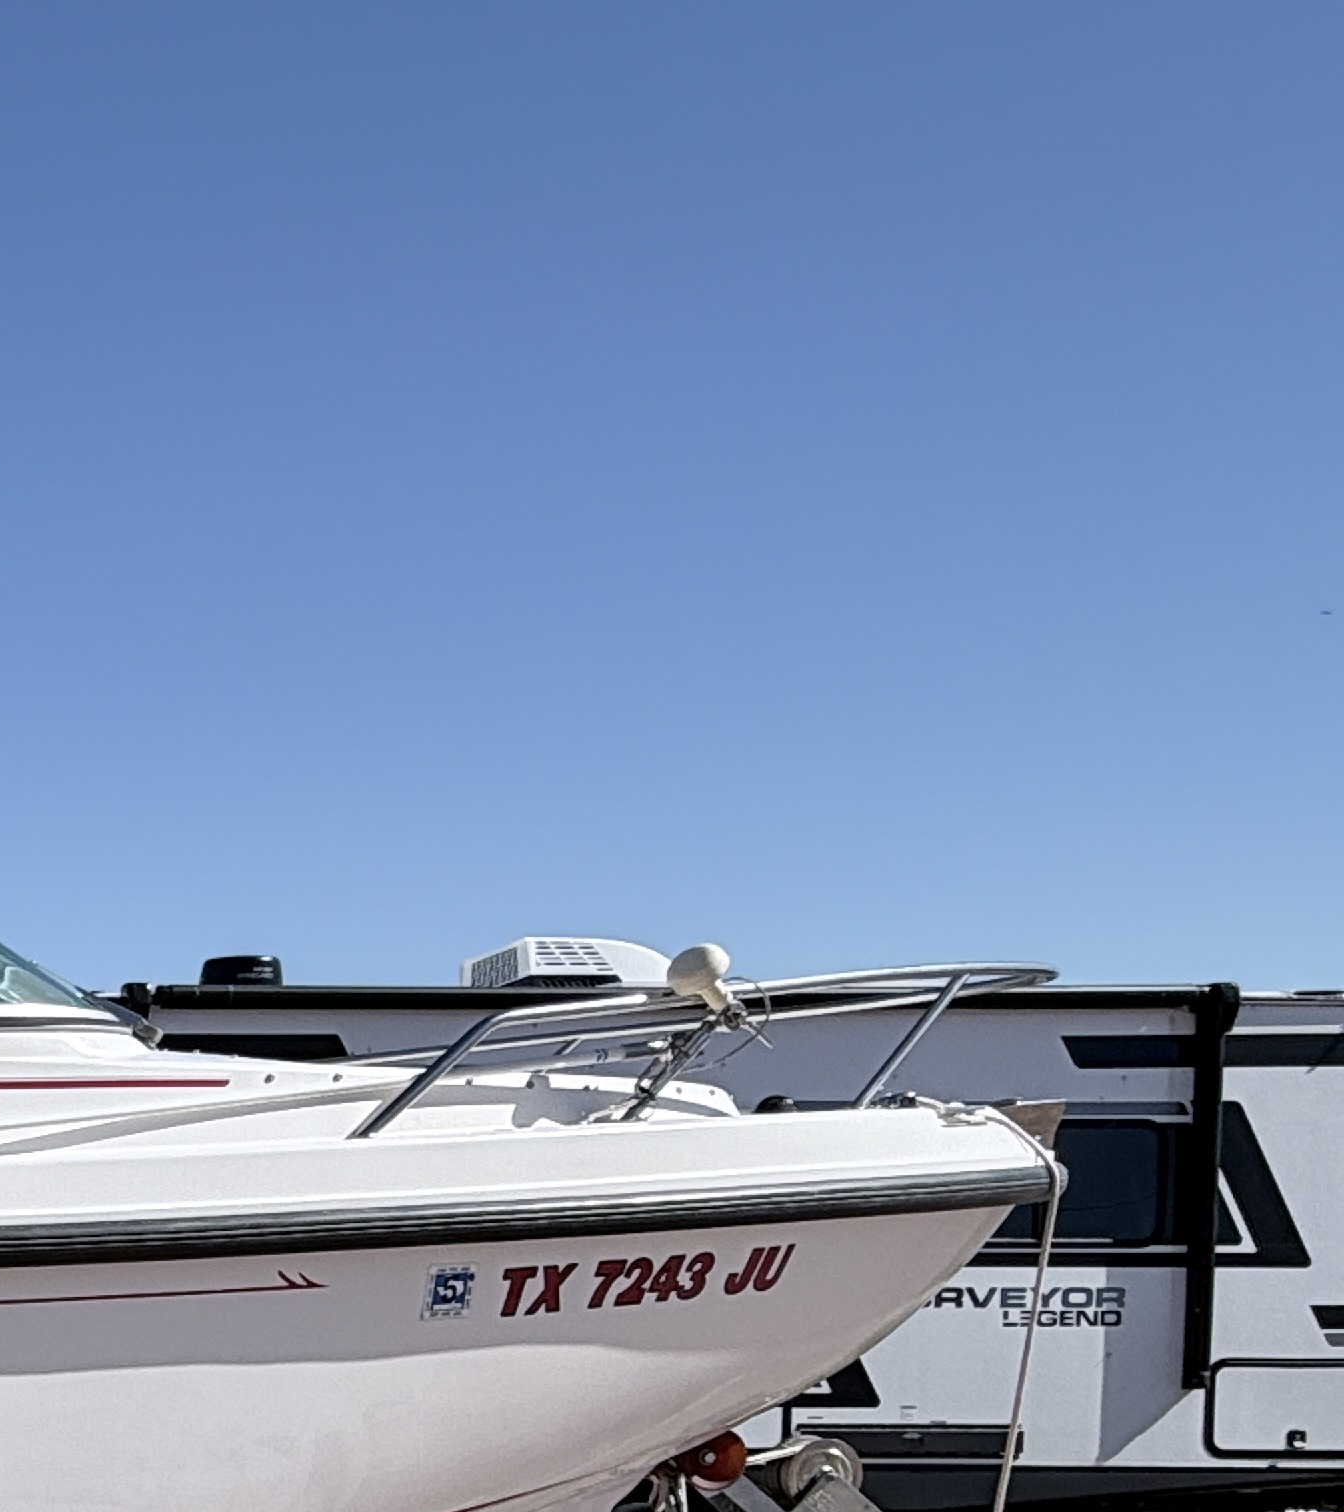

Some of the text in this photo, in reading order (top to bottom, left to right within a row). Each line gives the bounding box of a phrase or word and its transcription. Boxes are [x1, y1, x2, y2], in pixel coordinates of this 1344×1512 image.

[499, 1243, 796, 1318] TX 7243 JU
[923, 1286, 1127, 1309] RVEYOR
[1002, 1310, 1123, 1328] LEGEND
